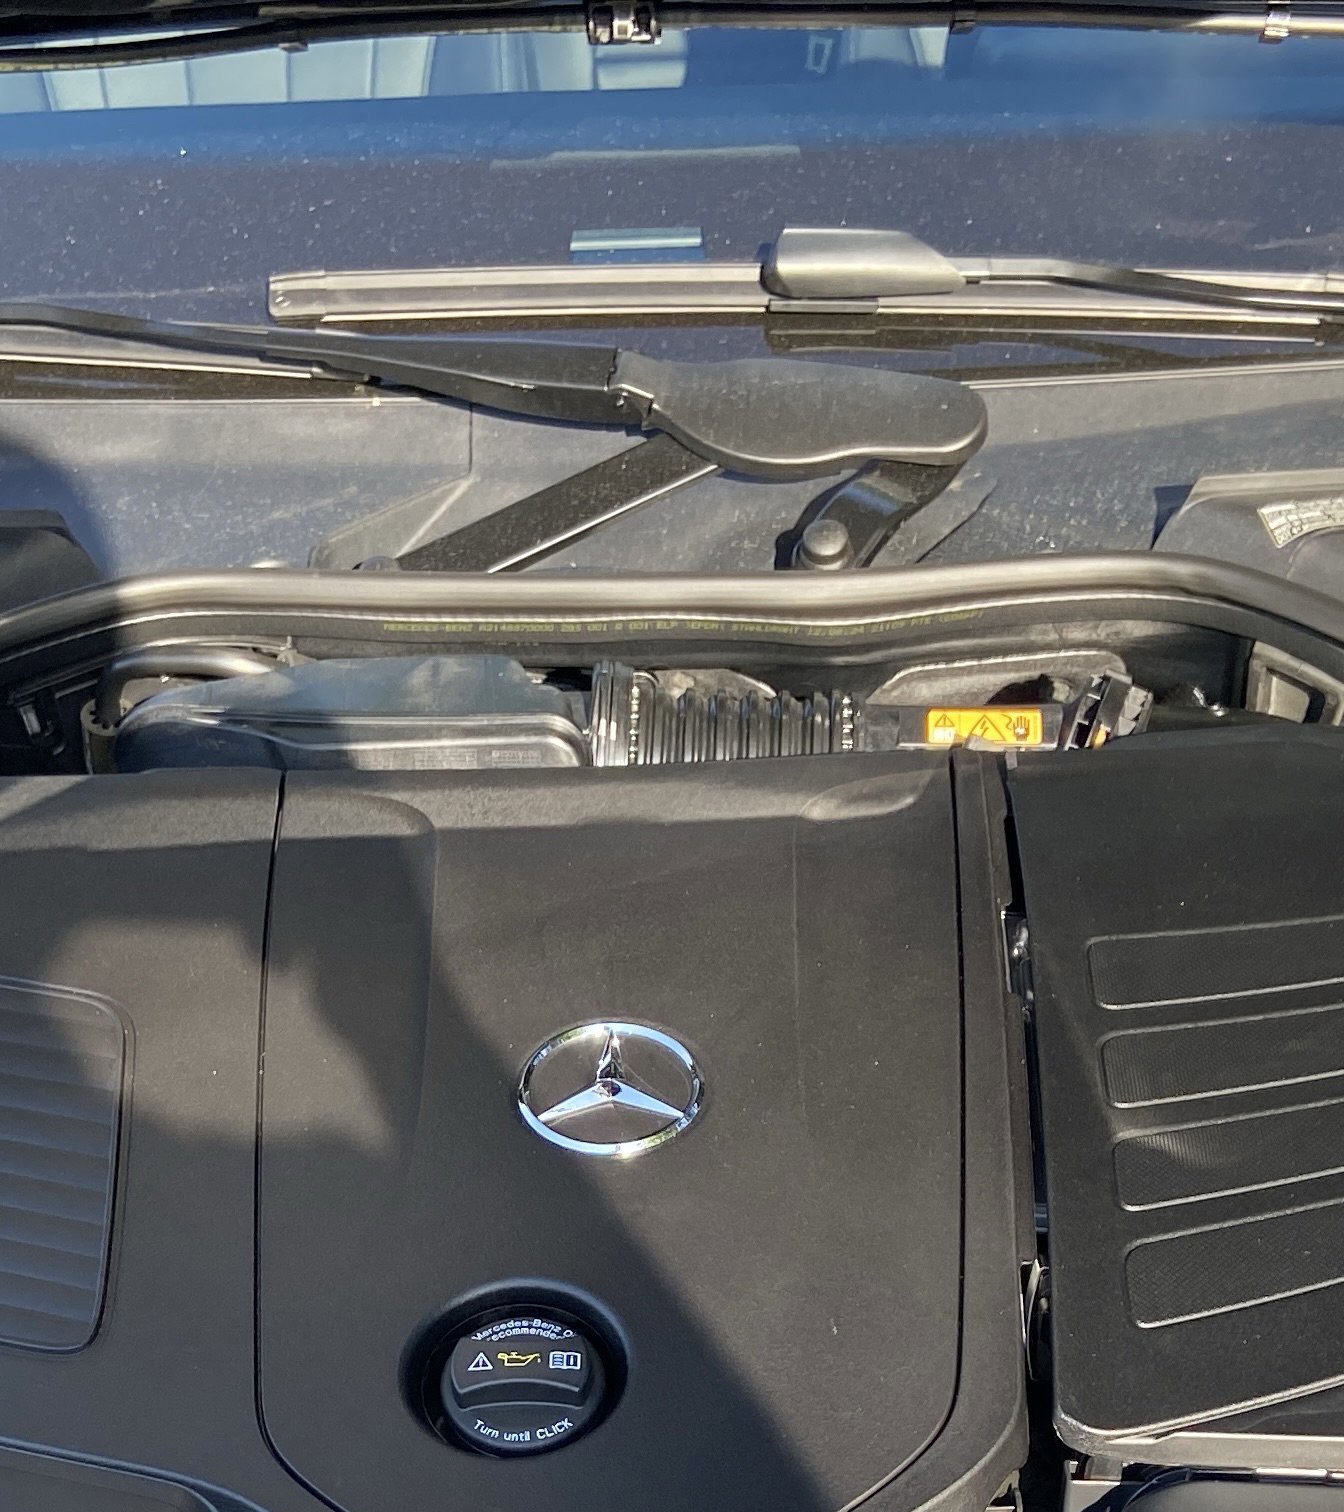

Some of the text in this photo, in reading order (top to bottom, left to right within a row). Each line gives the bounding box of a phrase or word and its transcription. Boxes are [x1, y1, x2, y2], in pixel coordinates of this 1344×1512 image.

[471, 1318, 560, 1341] Mercedes-Benz
[473, 1418, 574, 1442] Turn until CLICK
